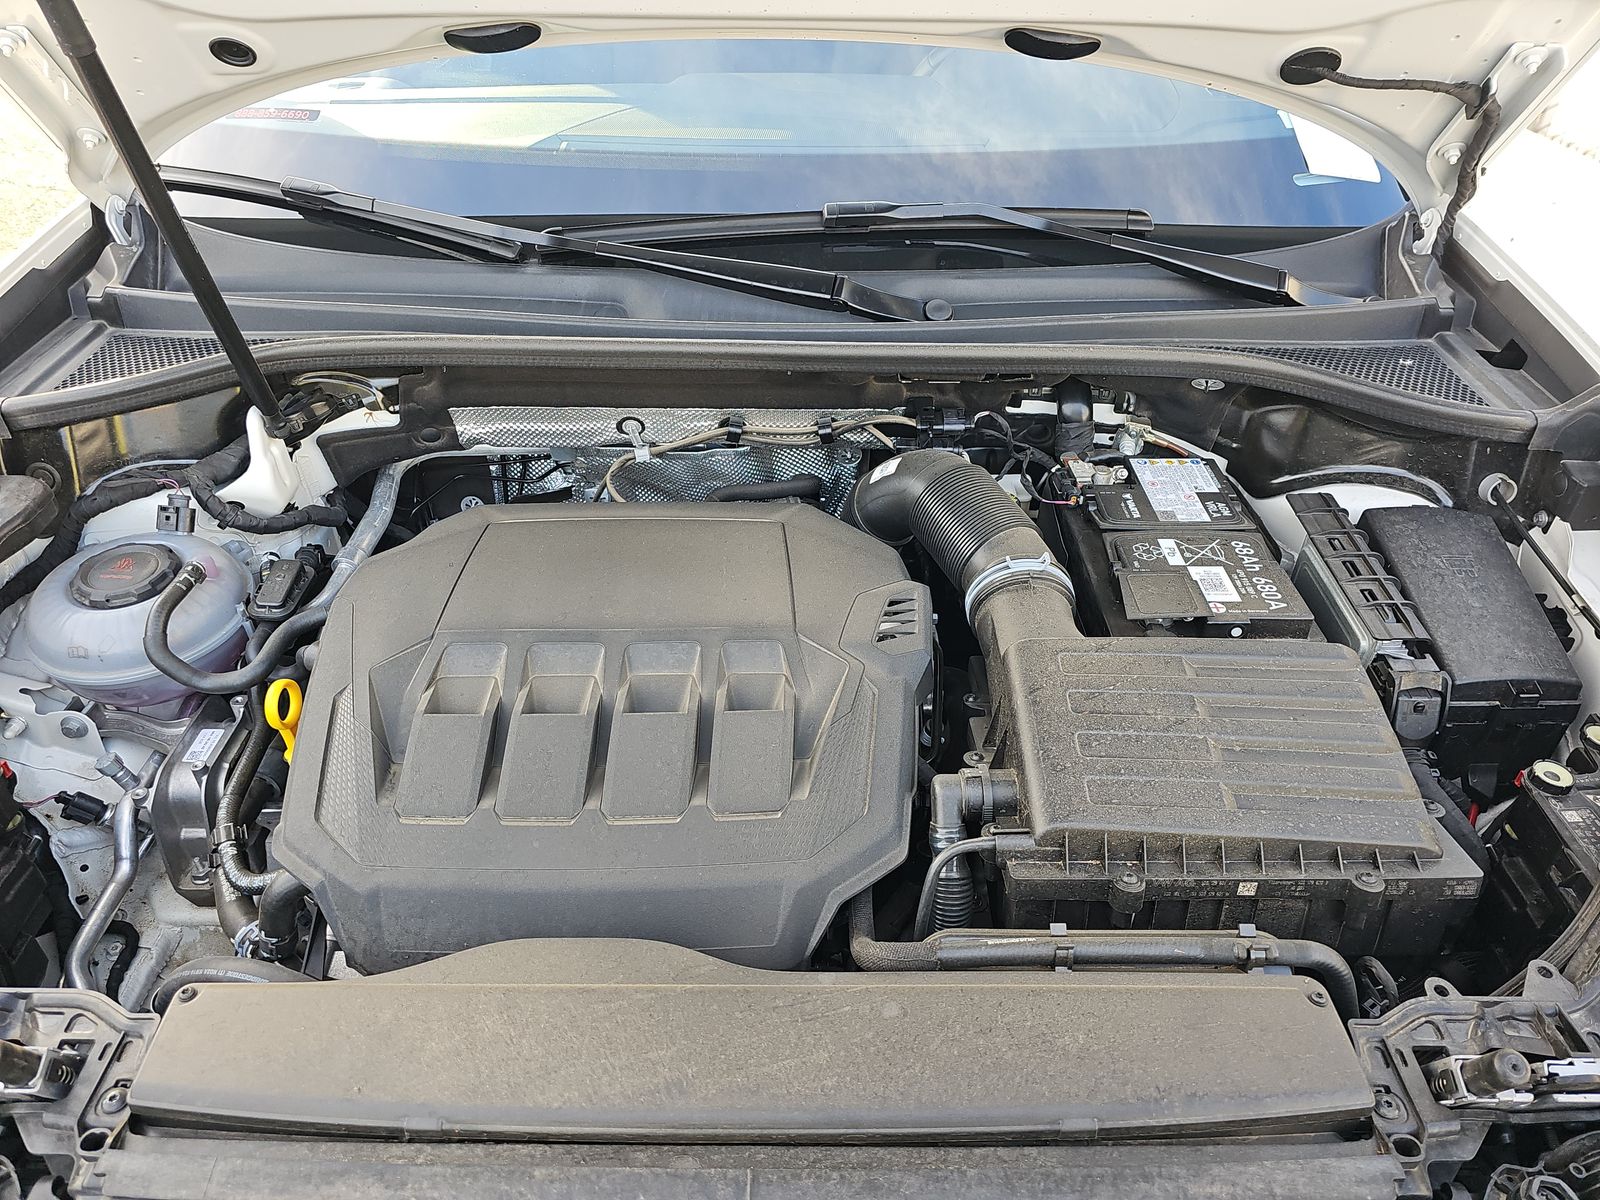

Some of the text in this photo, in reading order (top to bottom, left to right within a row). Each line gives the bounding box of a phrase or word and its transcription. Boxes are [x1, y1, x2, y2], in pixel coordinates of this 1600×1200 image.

[1125, 499, 1142, 519] VARTA
[1204, 501, 1222, 518] VRLA
[1215, 502, 1233, 516] AGM
[1230, 540, 1288, 610] 68Ah 680A
